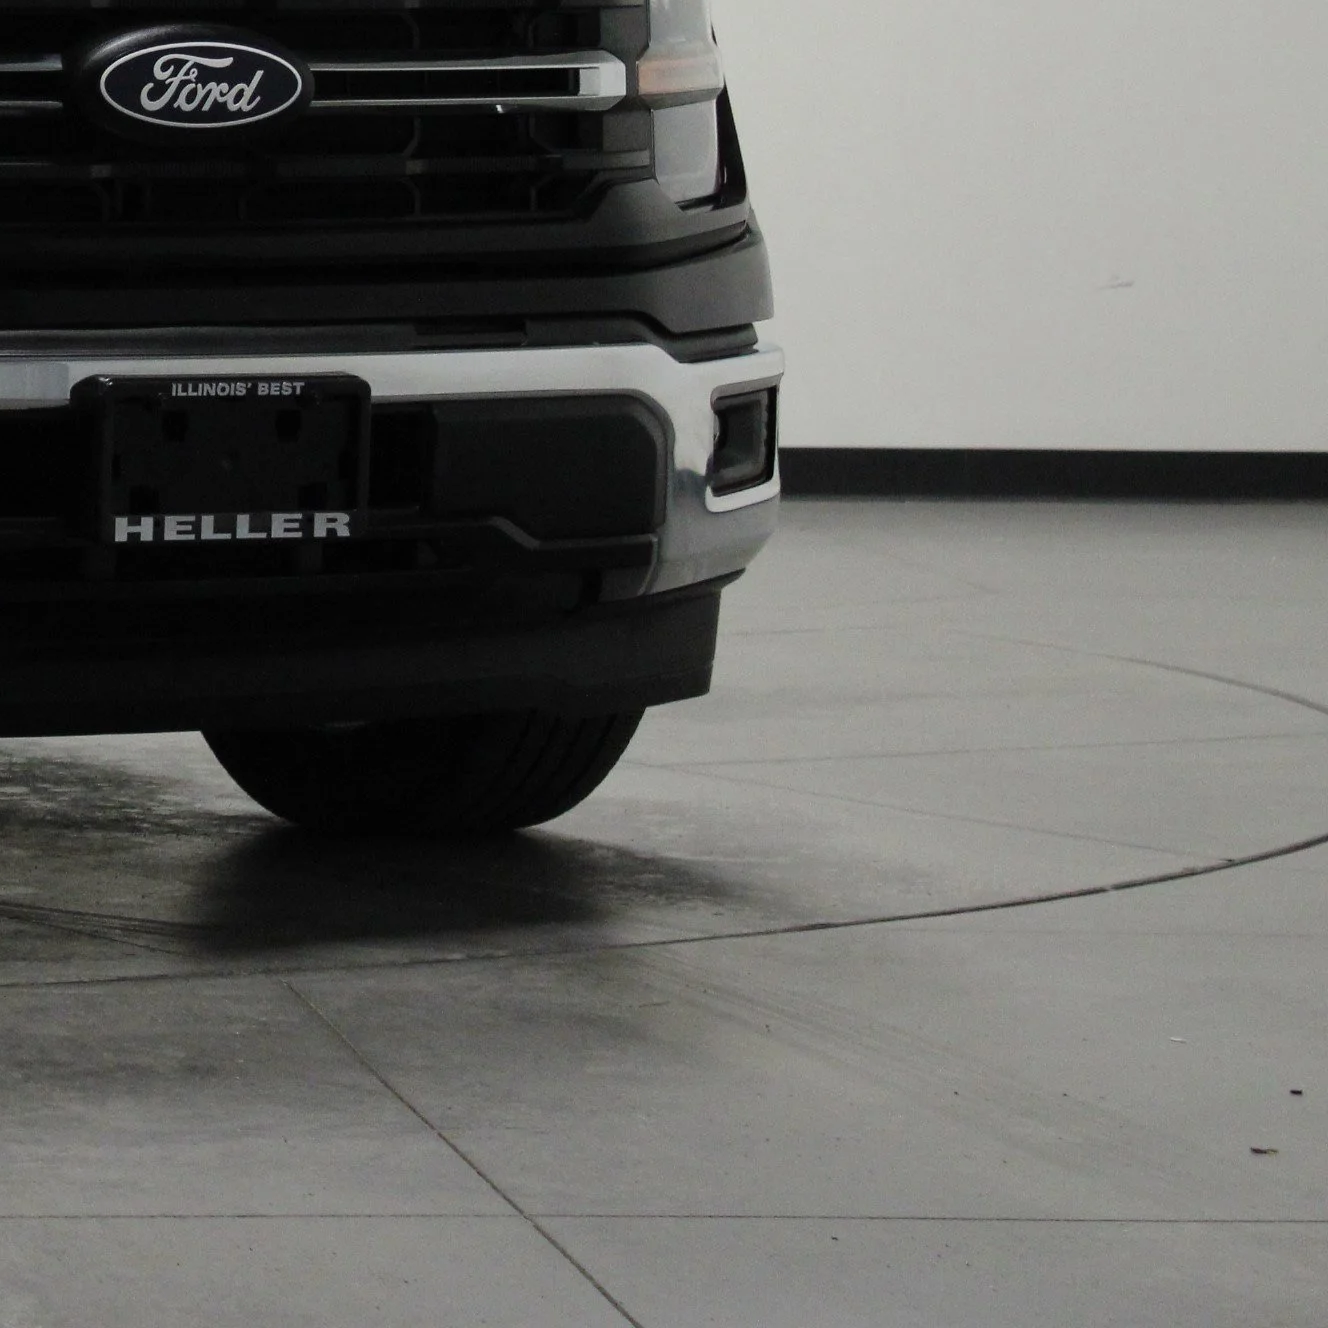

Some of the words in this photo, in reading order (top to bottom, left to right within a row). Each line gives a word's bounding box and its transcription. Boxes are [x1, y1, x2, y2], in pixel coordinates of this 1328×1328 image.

[141, 53, 264, 112] Ford
[172, 382, 253, 397] ILLINOIS'
[257, 382, 305, 396] BEST
[114, 512, 351, 542] HELLER
